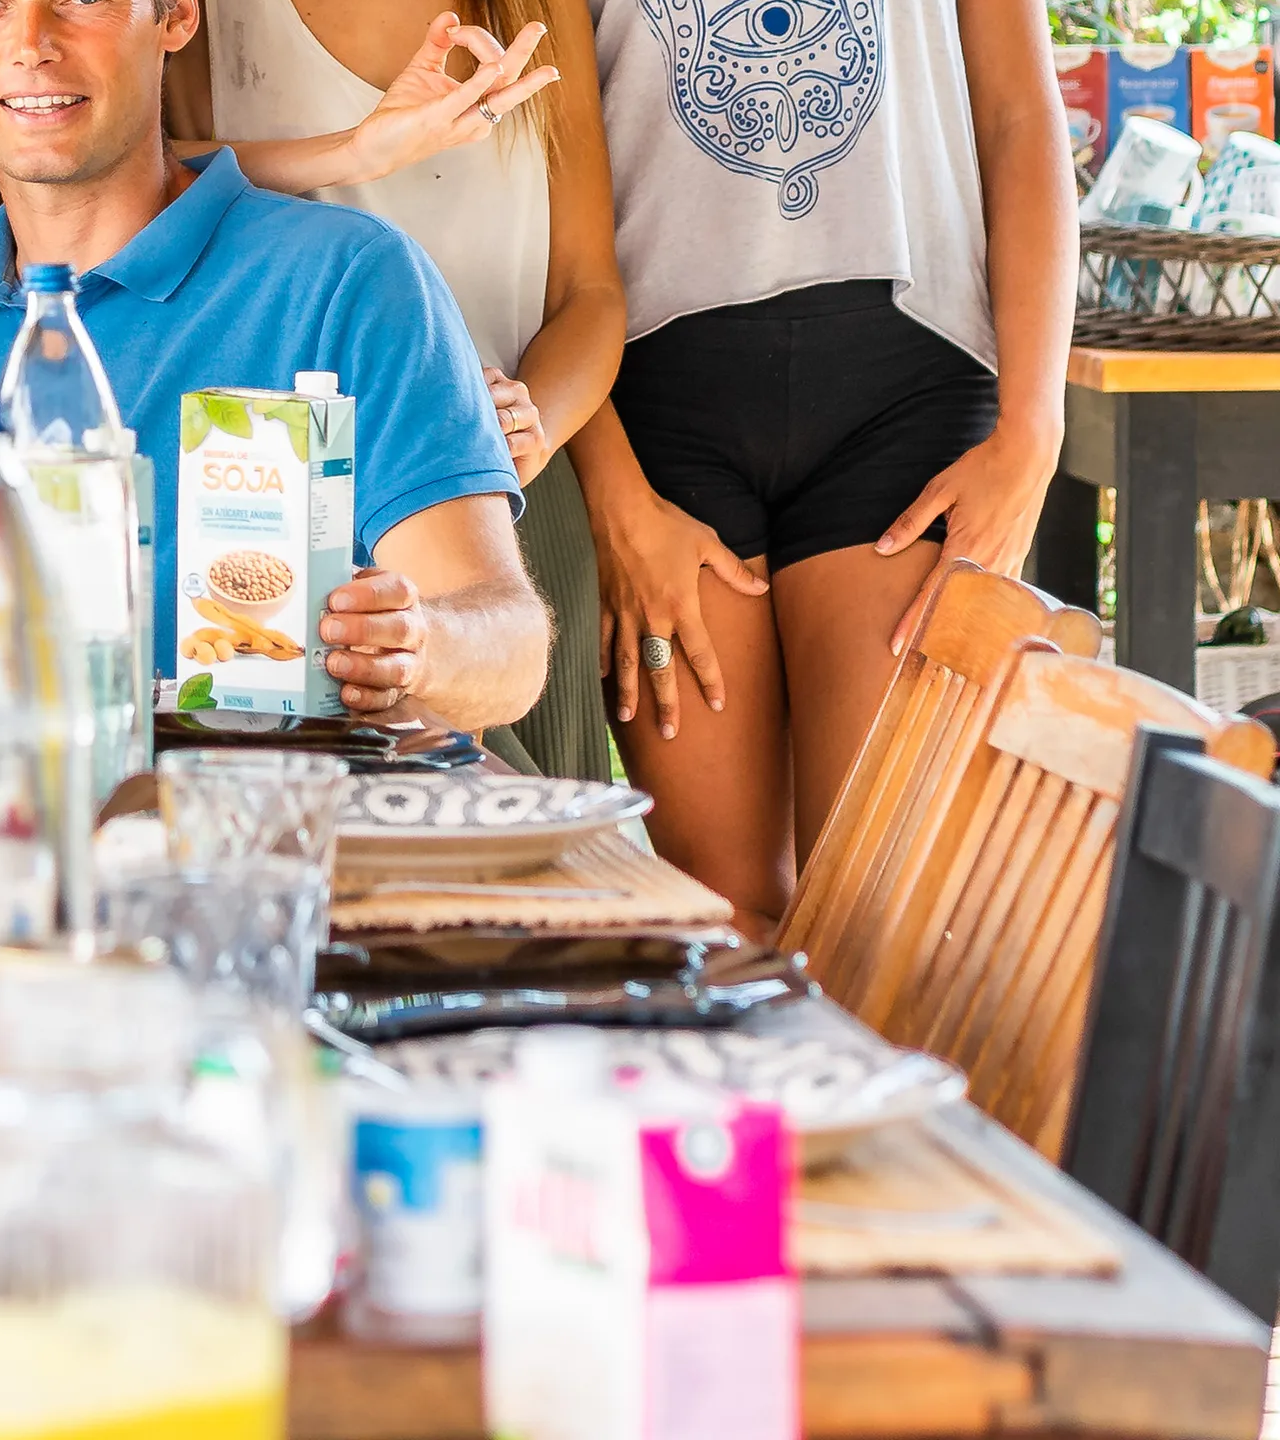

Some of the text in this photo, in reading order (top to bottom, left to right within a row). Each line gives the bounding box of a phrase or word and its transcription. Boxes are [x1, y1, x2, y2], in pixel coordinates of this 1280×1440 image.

[202, 462, 285, 495] SOJA
[201, 508, 213, 517] SIN
[282, 699, 296, 712] 1L
